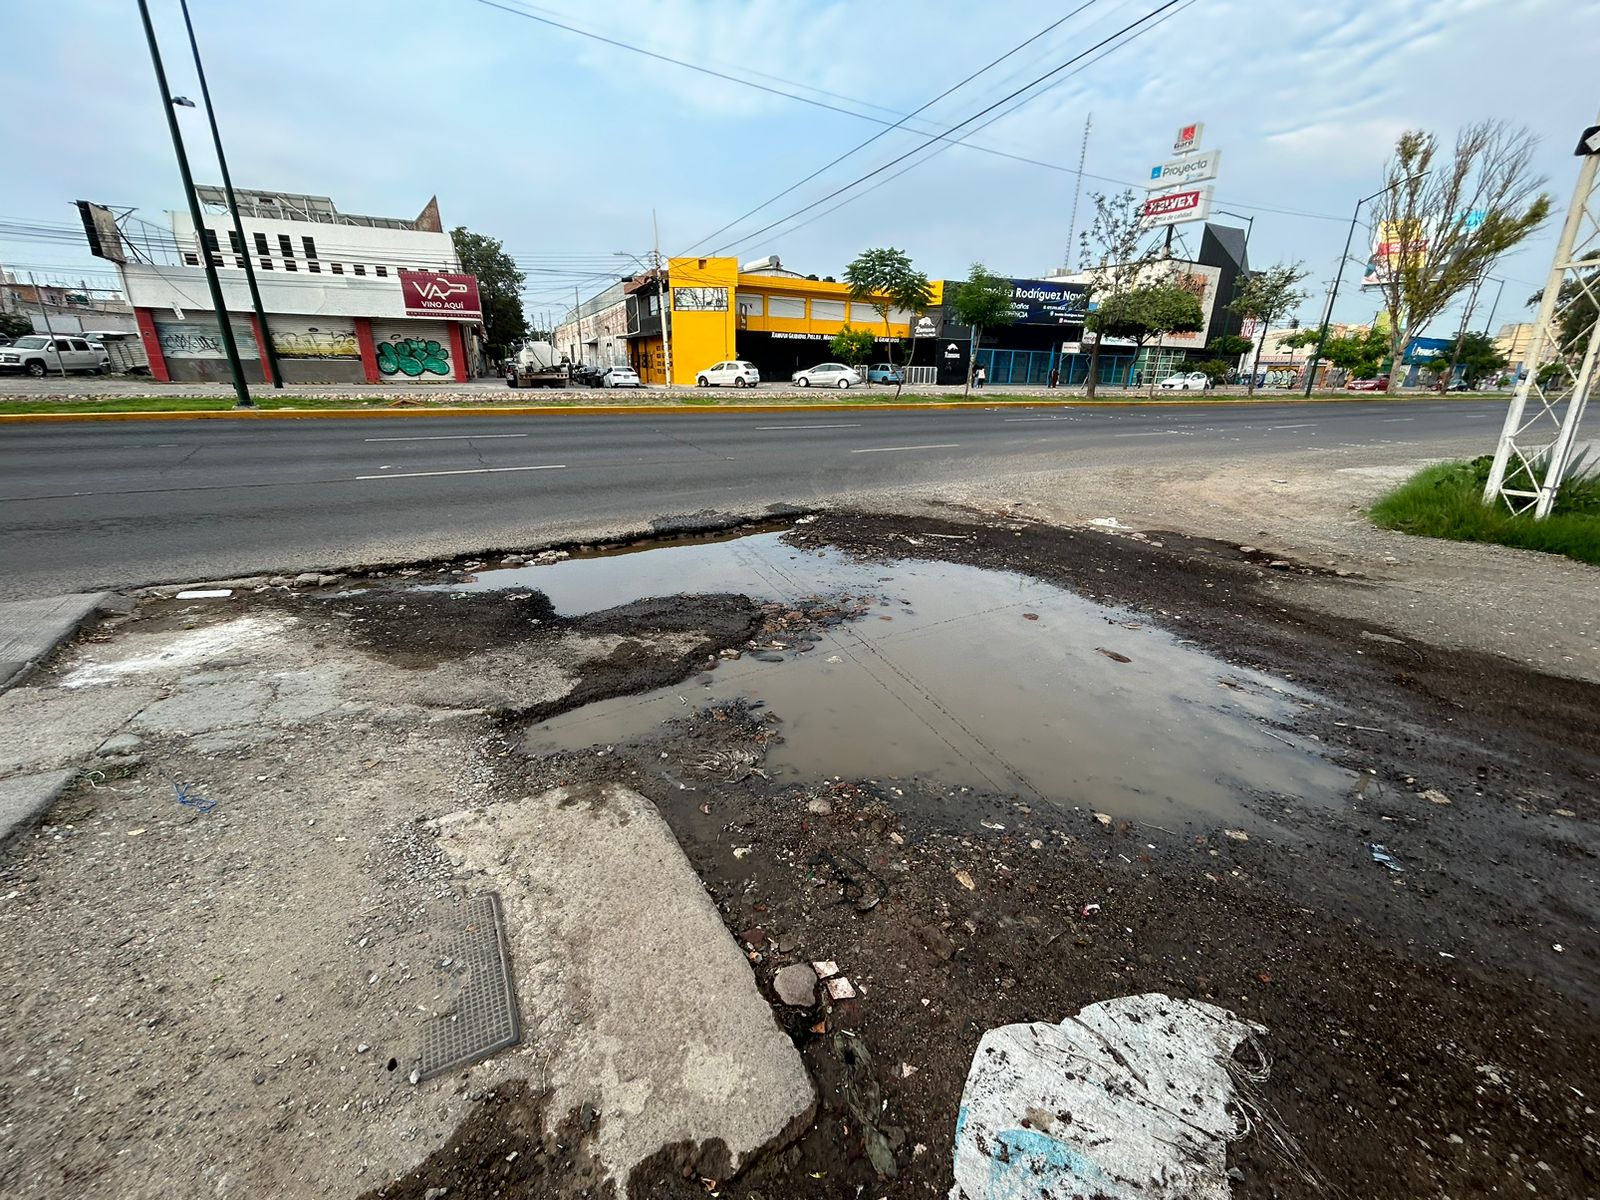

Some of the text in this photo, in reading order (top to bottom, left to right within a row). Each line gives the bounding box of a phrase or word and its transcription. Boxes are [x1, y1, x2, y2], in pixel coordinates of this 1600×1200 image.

[1162, 160, 1208, 177] Proyecta
[1015, 287, 1061, 301] Rodríguez
[420, 300, 464, 309] VINO AQUÍ
